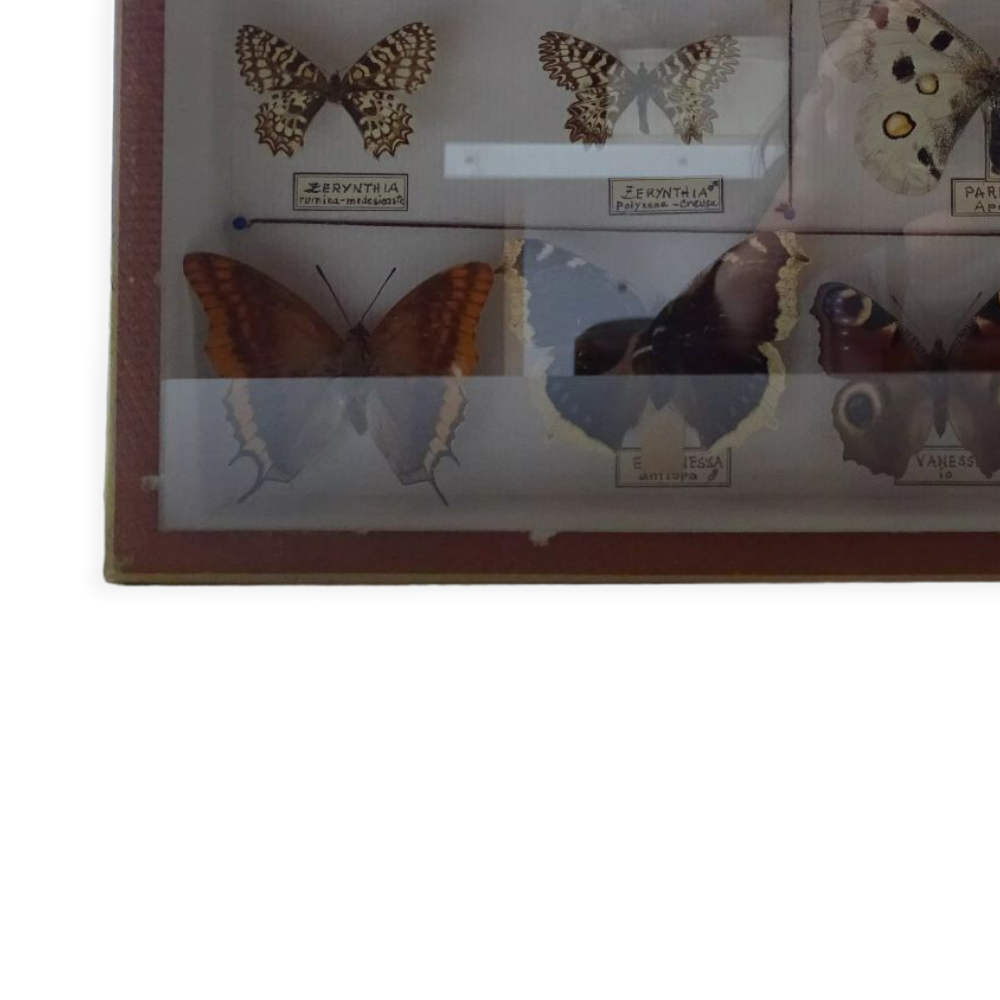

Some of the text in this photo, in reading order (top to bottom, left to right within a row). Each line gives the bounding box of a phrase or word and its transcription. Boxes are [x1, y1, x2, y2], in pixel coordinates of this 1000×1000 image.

[303, 182, 399, 193] ZERYNTHIA
[620, 185, 708, 199] ZERYNTHIA
[916, 454, 975, 469] VANESS
